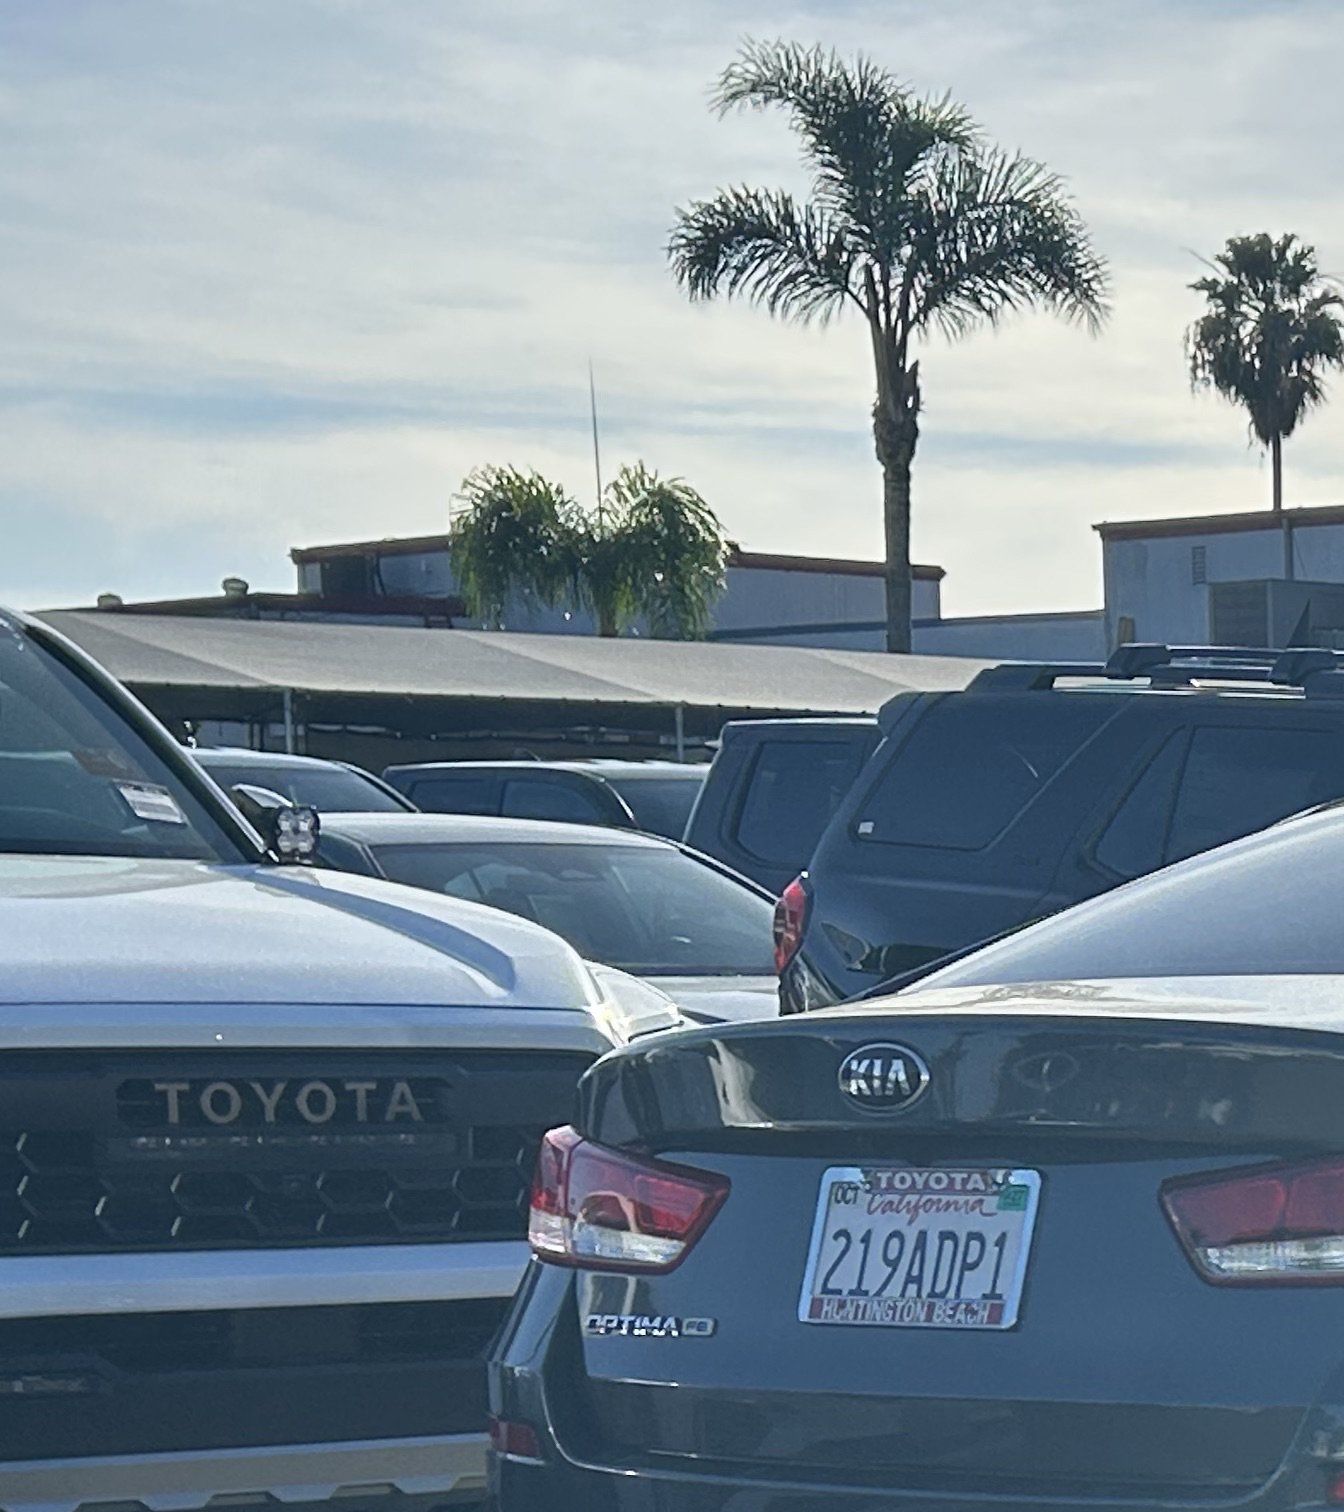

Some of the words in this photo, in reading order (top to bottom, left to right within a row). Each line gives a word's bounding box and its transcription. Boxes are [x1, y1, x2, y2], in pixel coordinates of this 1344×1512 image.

[849, 1059, 911, 1096] KIA
[155, 1081, 424, 1124] TOYOTA
[834, 1184, 861, 1204] OCT
[876, 1171, 986, 1191] TOYOTA
[866, 1193, 998, 1226] California
[820, 1228, 1008, 1300] 219ADP1
[585, 1314, 679, 1337] OPTIMA
[820, 1299, 927, 1323] HUNTINGTON
[932, 1301, 989, 1325] BEACH
